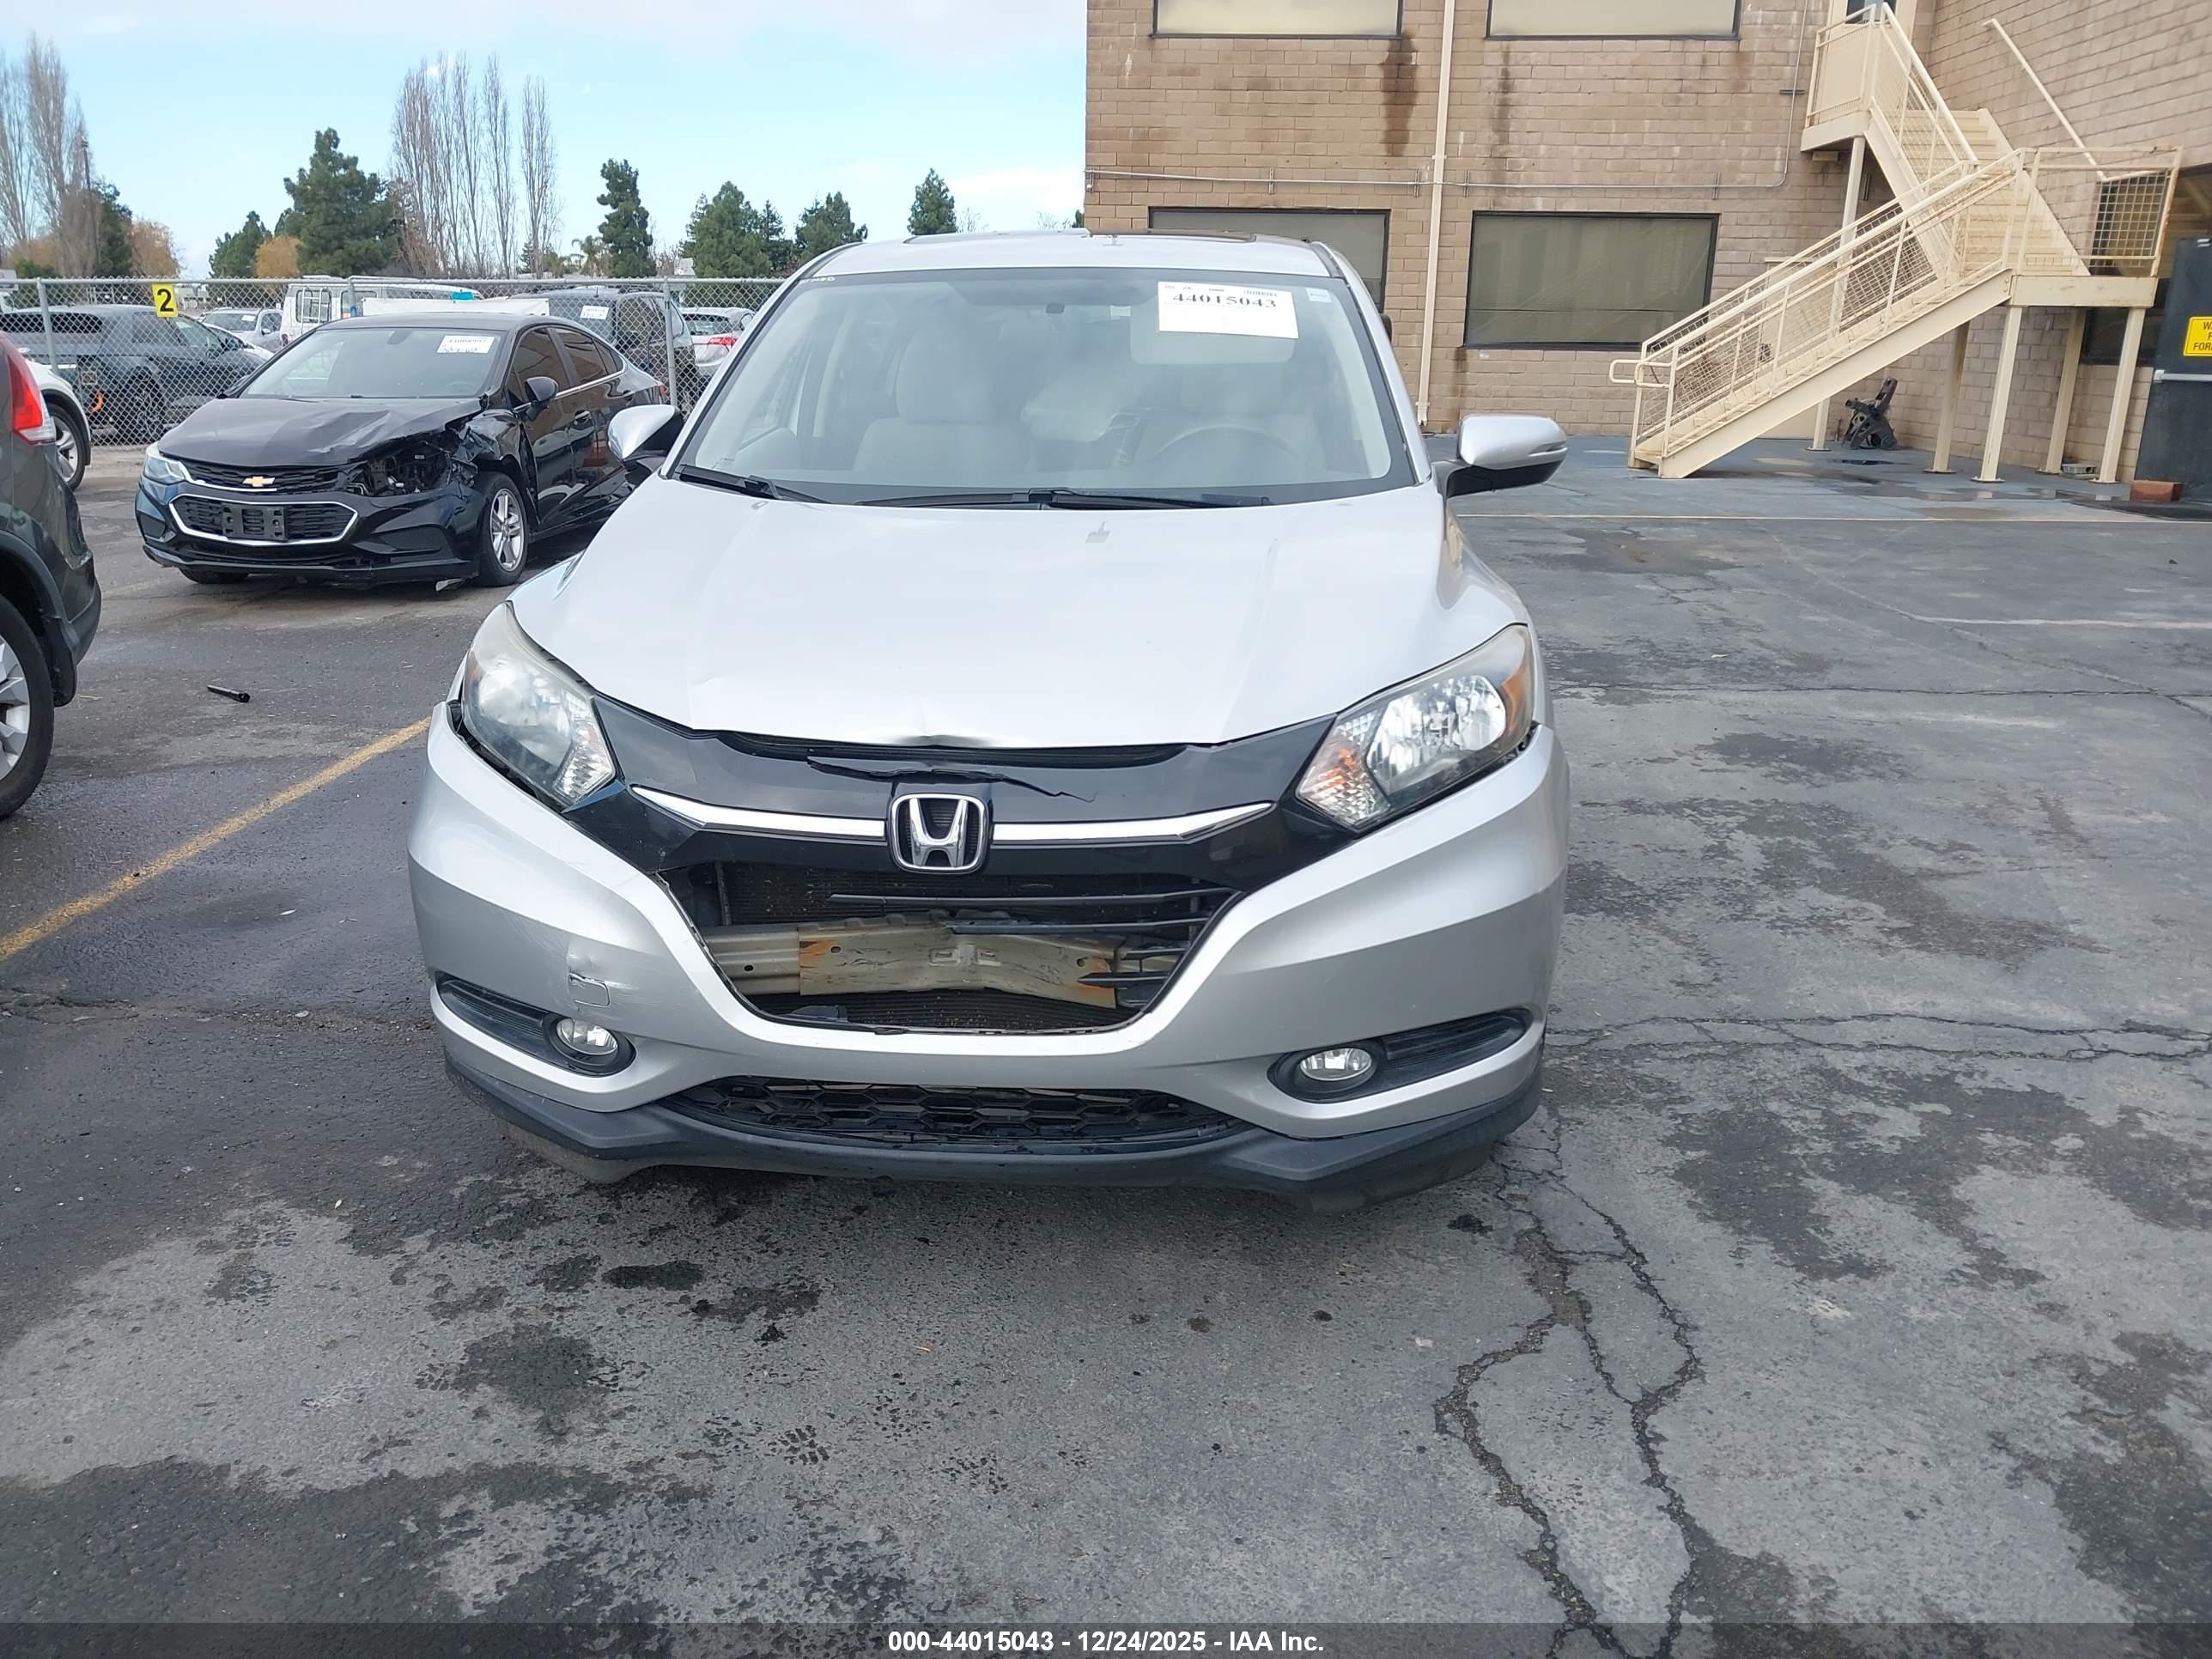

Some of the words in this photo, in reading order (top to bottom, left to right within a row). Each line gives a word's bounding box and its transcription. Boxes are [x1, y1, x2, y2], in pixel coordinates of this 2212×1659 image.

[157, 289, 174, 312] 2
[1173, 293, 1277, 308] 44015043
[2203, 321, 2212, 330] W
[2192, 342, 2212, 351] FOR
